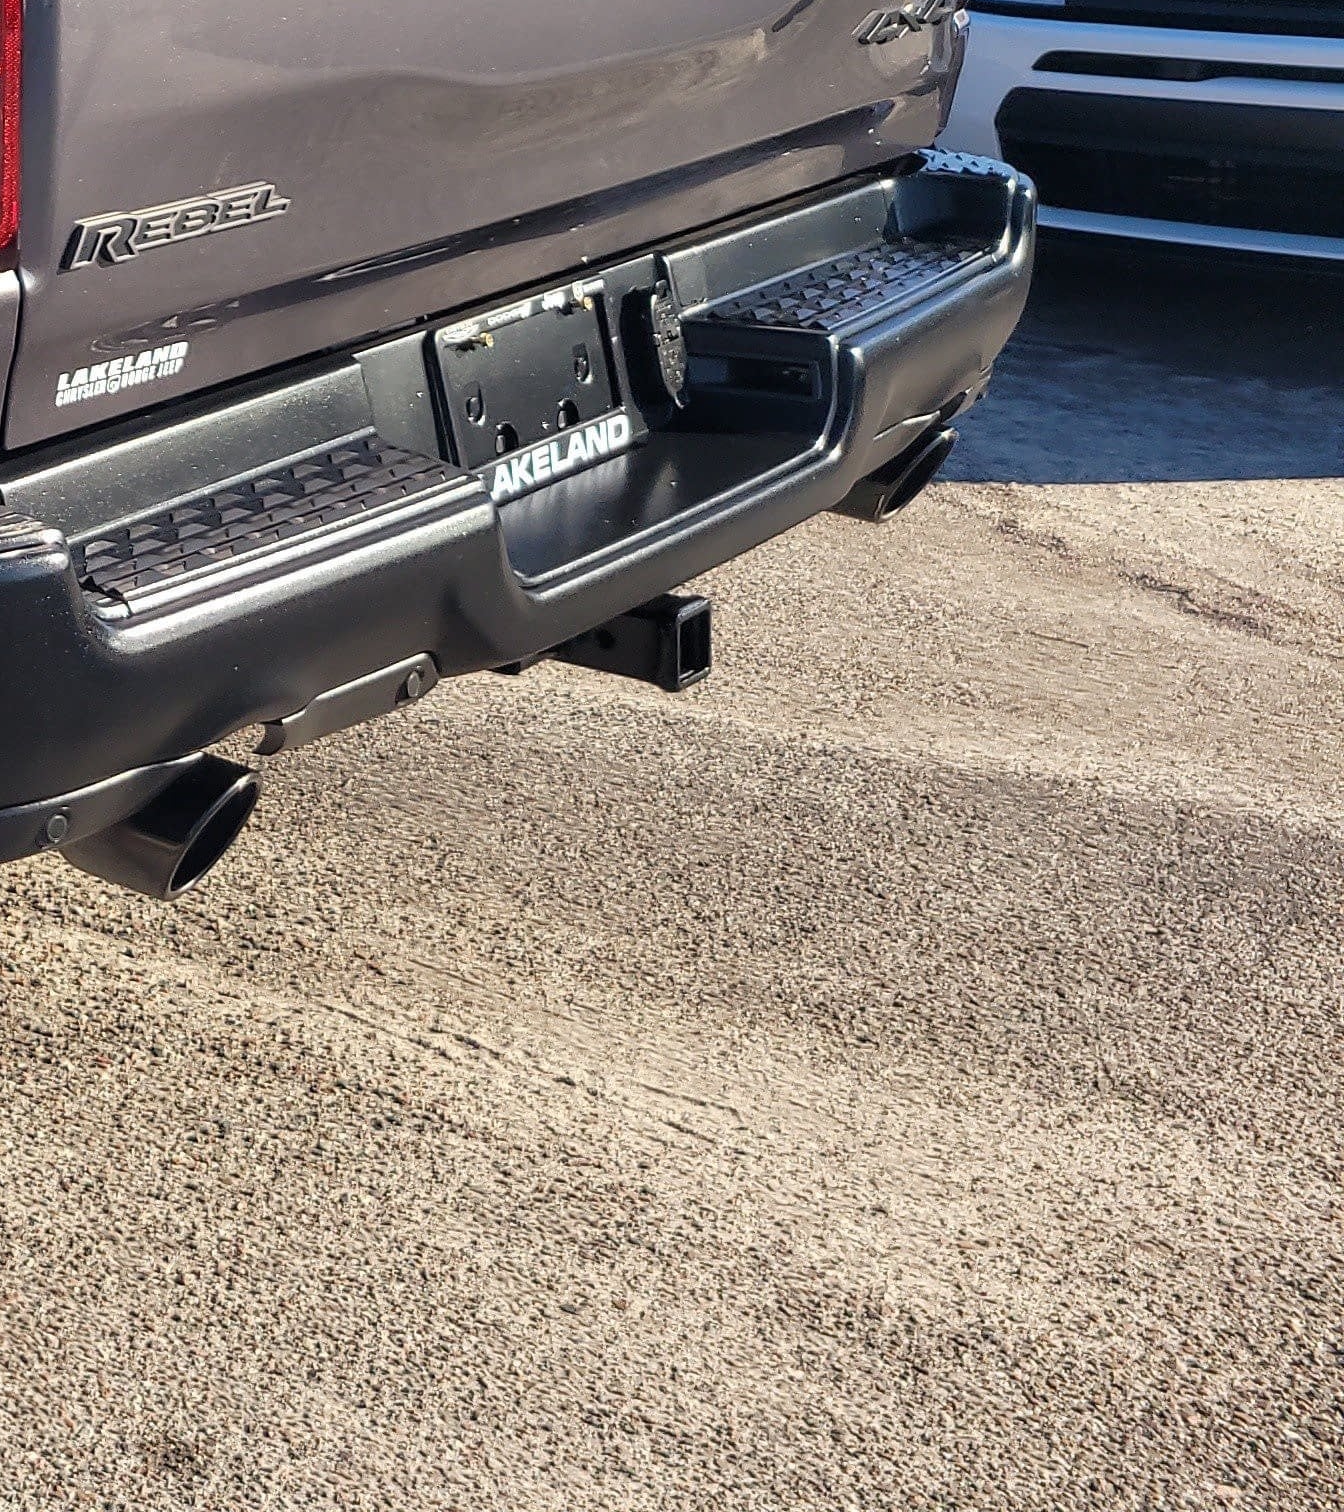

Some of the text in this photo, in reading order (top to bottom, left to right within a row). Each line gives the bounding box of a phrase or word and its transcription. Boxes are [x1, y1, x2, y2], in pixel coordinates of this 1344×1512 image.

[57, 181, 291, 275] REBEL
[56, 341, 189, 391] LAKELAND
[490, 414, 632, 502] AKELAND
